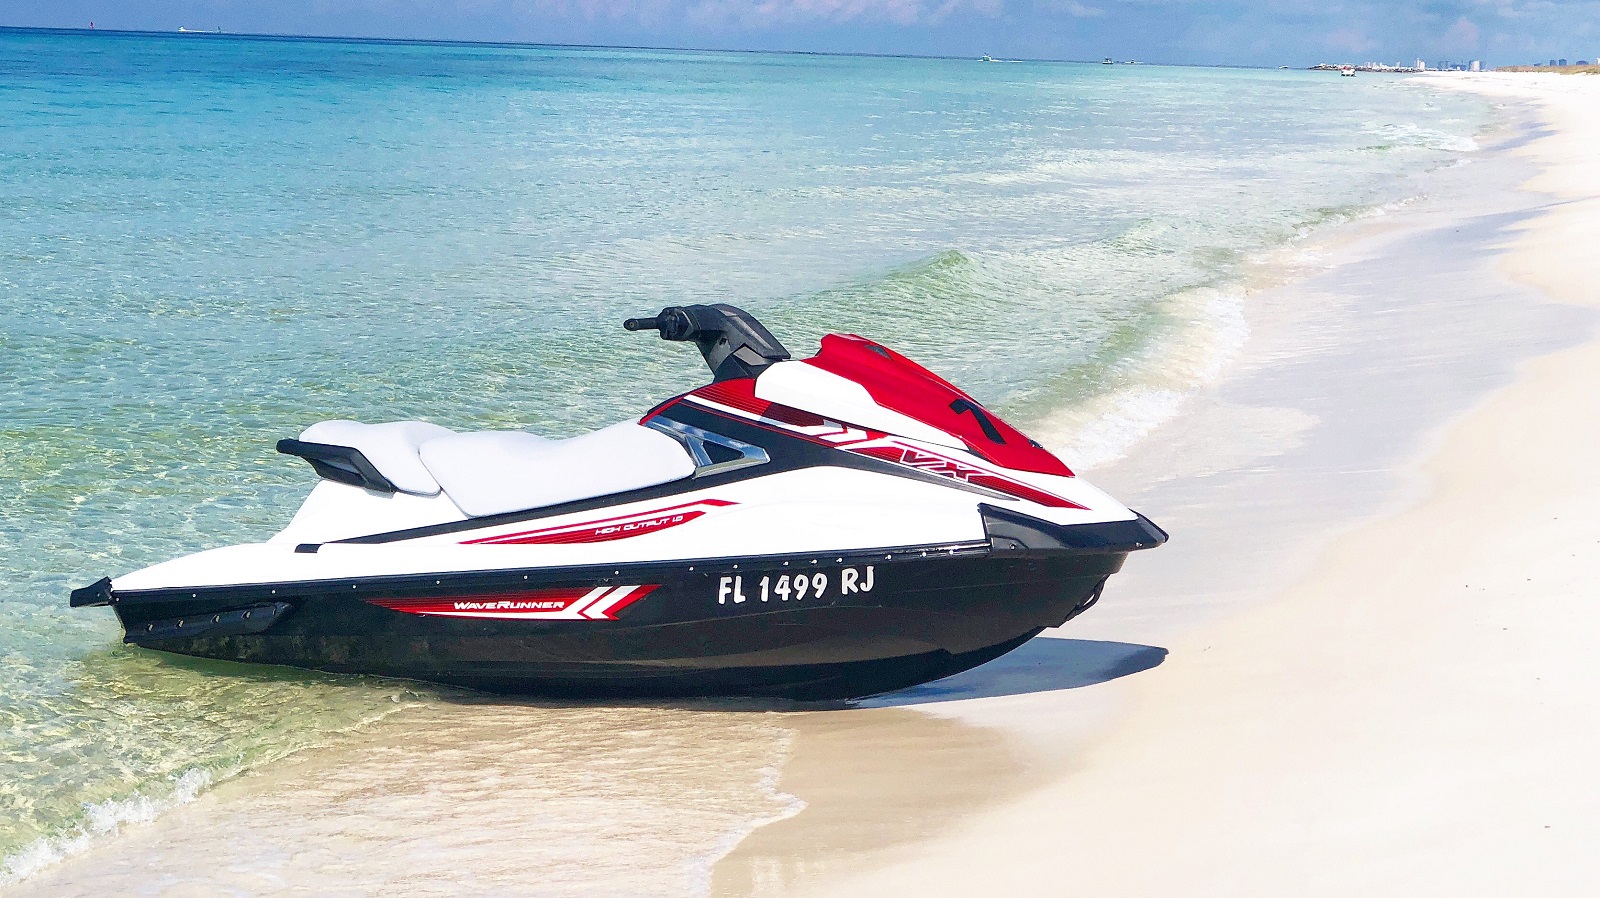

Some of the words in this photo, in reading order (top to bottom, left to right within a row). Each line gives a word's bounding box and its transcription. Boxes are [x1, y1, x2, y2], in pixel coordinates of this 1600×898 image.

[901, 448, 985, 481] VX
[595, 525, 621, 535] HIGH
[623, 518, 669, 531] OUTPUT
[718, 576, 746, 605] FL
[759, 573, 828, 602] 1499
[841, 565, 875, 595] RJ
